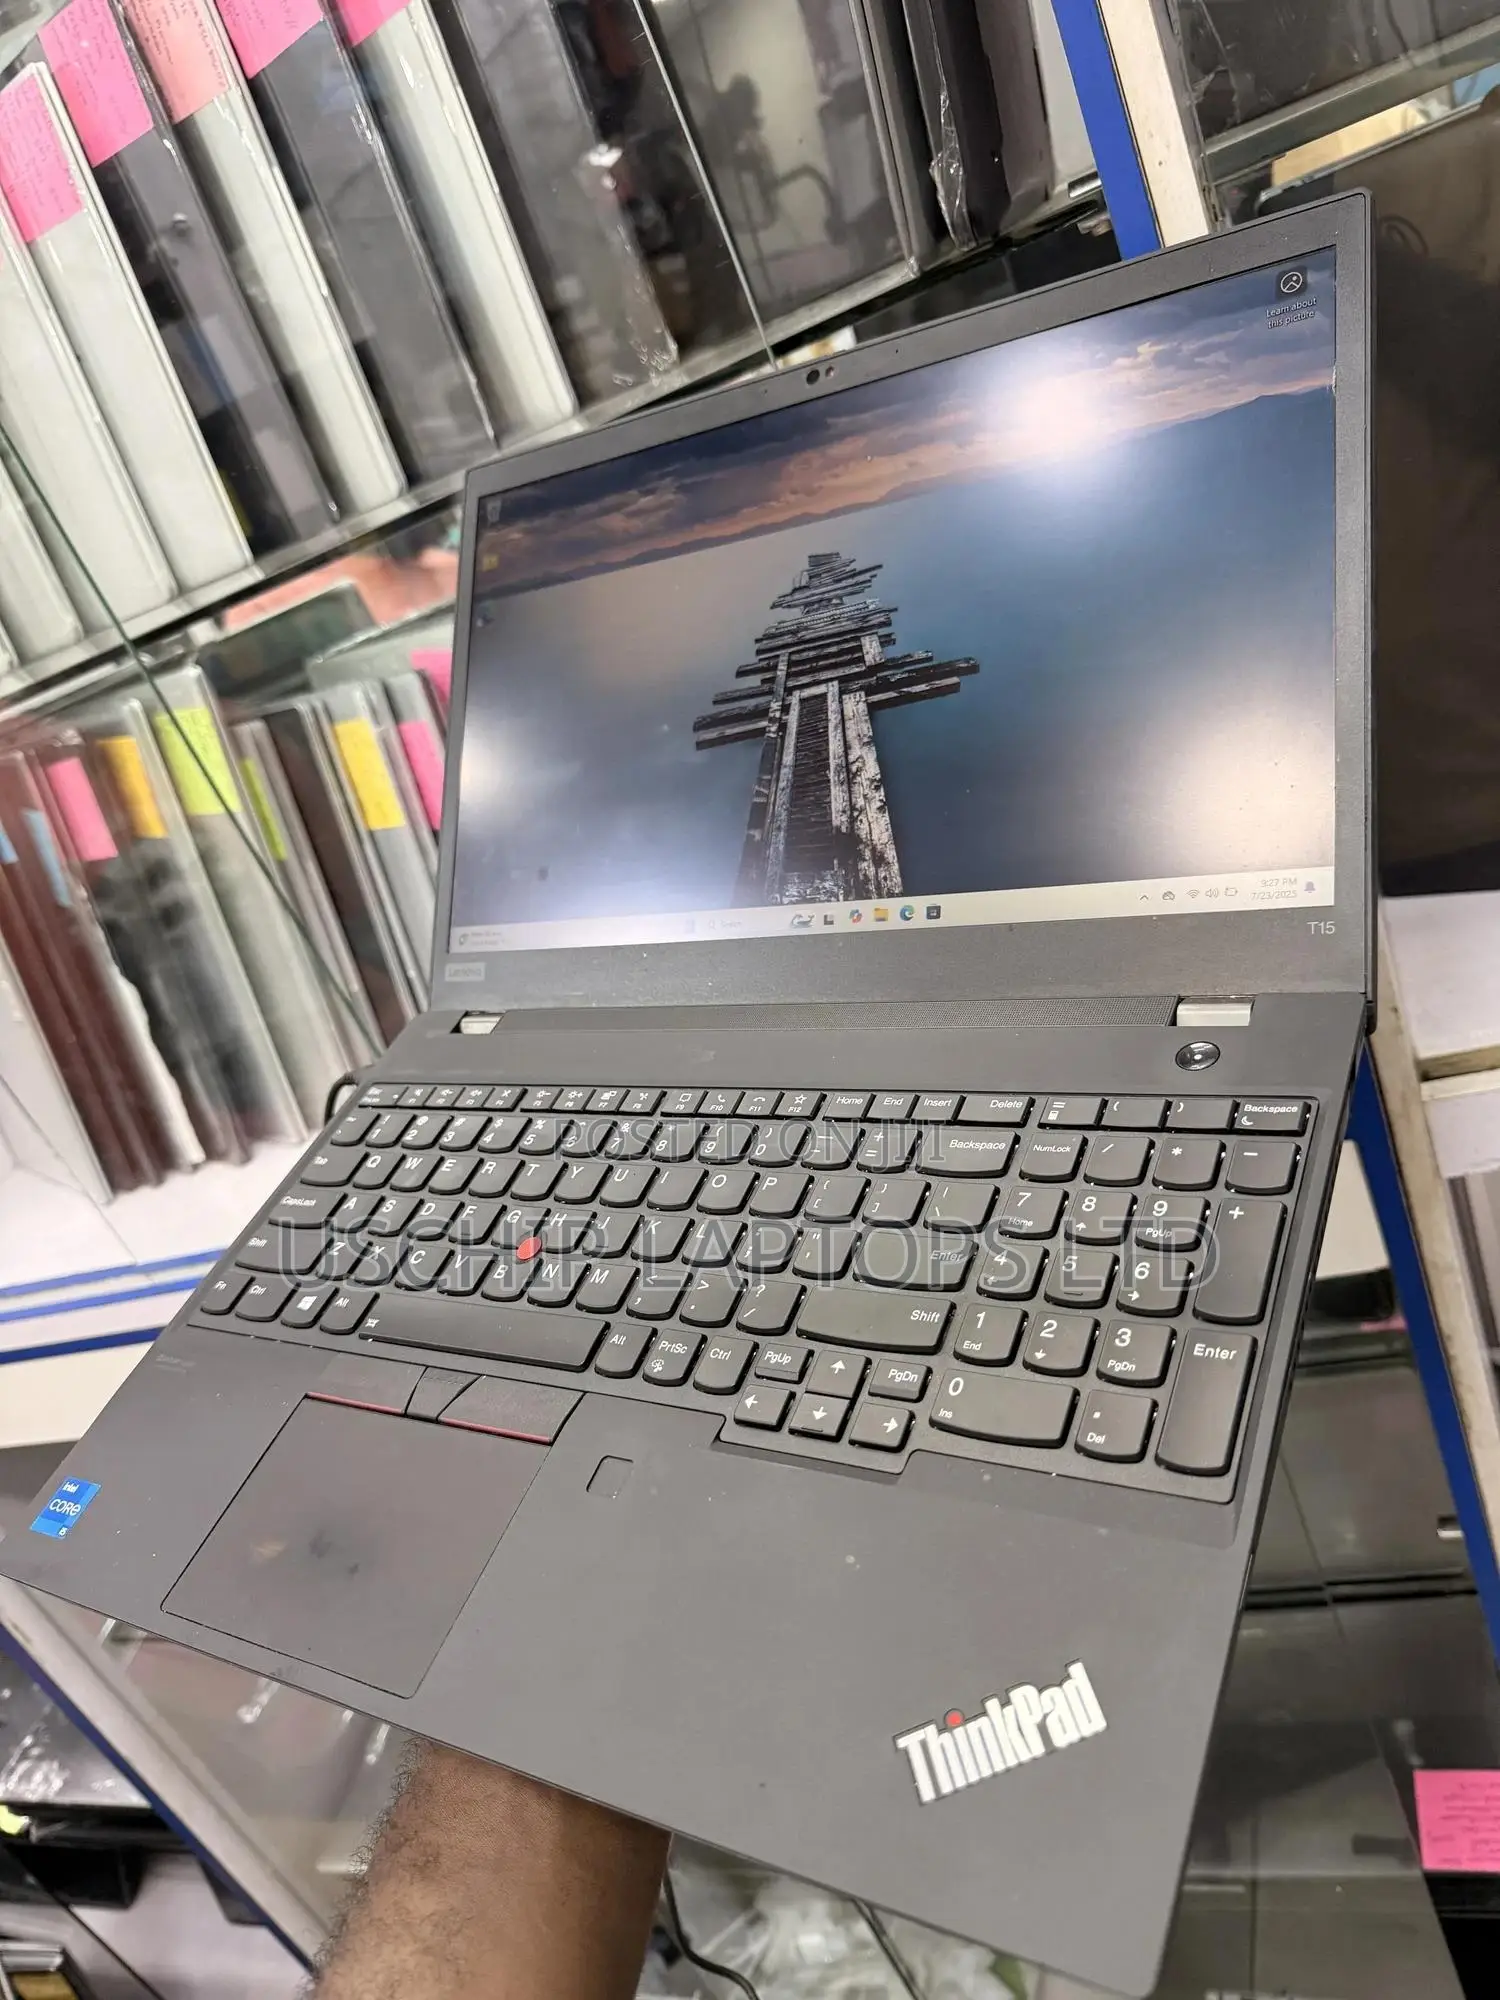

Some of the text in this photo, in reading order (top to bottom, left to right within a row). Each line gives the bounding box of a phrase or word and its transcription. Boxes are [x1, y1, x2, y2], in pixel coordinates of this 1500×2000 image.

[1266, 298, 1316, 317] Learn about
[1268, 311, 1314, 329] this picture
[1307, 921, 1335, 934] T15
[836, 1096, 863, 1105] Home
[884, 1097, 903, 1106] End
[924, 1098, 952, 1107] Insert
[990, 1100, 1022, 1109] Delete
[1244, 1104, 1298, 1113] Backspace
[404, 1130, 418, 1140] 2
[444, 1131, 455, 1142] 3
[483, 1133, 494, 1143] 4
[523, 1134, 535, 1145] 5
[566, 1136, 578, 1147] 6
[610, 1138, 622, 1149] 7
[656, 1140, 667, 1151] 8
[705, 1142, 716, 1152] 9
[950, 1140, 1005, 1150] Backspace
[366, 1156, 381, 1168] Q
[404, 1157, 423, 1169] W
[441, 1160, 456, 1171] E
[481, 1162, 497, 1174] R
[527, 1164, 540, 1176] T
[570, 1166, 584, 1179] Y
[614, 1169, 629, 1182] U
[762, 1177, 777, 1190] P
[343, 1197, 356, 1209] A
[383, 1200, 396, 1213] S
[1017, 1193, 1031, 1207] 7
[1082, 1196, 1096, 1211] 8
[421, 1203, 436, 1216] D
[463, 1205, 477, 1217] F
[1152, 1201, 1168, 1216] 9
[1229, 1206, 1244, 1219] +
[507, 1210, 521, 1224] G
[551, 1214, 566, 1226] H
[597, 1217, 611, 1229] J
[1008, 1217, 1033, 1227] Home
[645, 1221, 661, 1234] K
[1146, 1228, 1173, 1238] PgUp
[329, 1242, 346, 1255] Z
[372, 1246, 385, 1260] X
[411, 1250, 426, 1264] C
[454, 1254, 469, 1268] V
[930, 1250, 962, 1261] Enter
[994, 1251, 1008, 1265] 4
[1062, 1256, 1077, 1271] 5
[493, 1265, 508, 1278] B
[542, 1264, 560, 1278] N
[590, 1269, 609, 1284] M
[1135, 1262, 1150, 1279] 6
[910, 1310, 940, 1323] Shift
[975, 1312, 987, 1328] 1
[1040, 1320, 1057, 1338] 2
[609, 1335, 626, 1345] Alt
[1114, 1329, 1132, 1347] 3
[659, 1341, 688, 1354] PrtSc
[963, 1341, 982, 1350] End
[1193, 1344, 1236, 1360] Enter
[710, 1348, 731, 1360] Ctrl
[764, 1351, 792, 1365] PgUp
[1108, 1359, 1135, 1372] PgDn
[888, 1369, 918, 1383] PgDn
[948, 1377, 964, 1396] 0
[939, 1409, 953, 1418] Ins
[1086, 1433, 1105, 1444] Del
[894, 1659, 1108, 1804] ThinkPad
